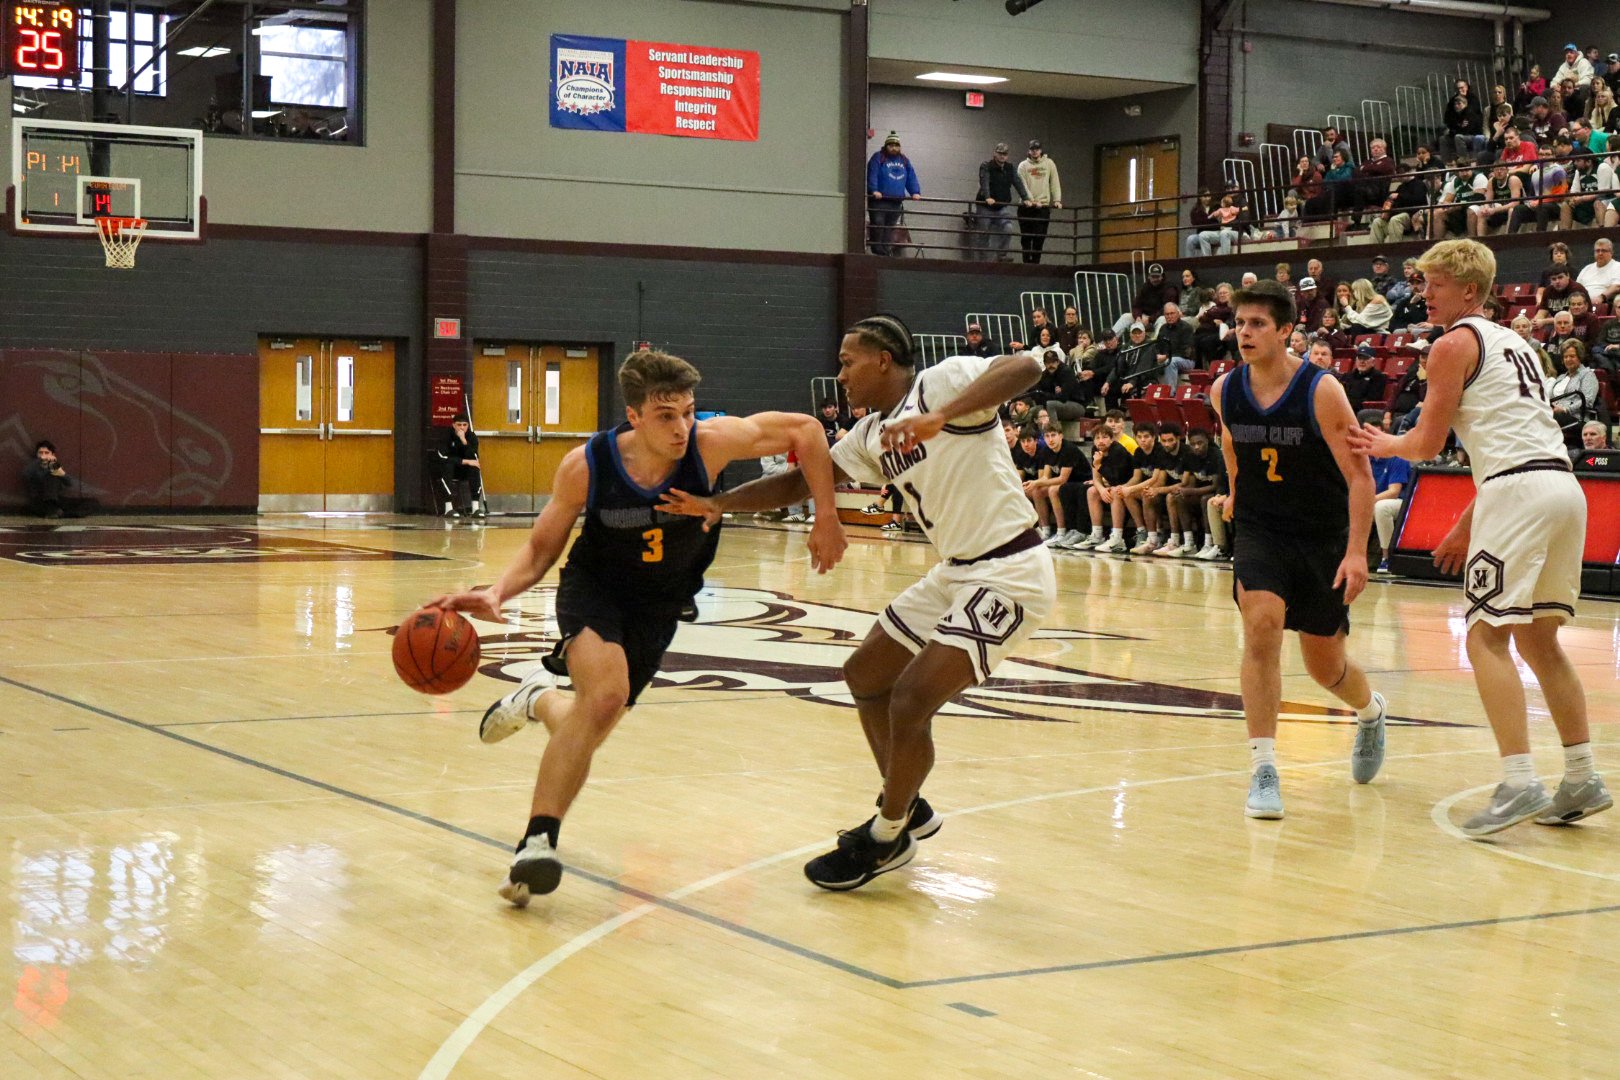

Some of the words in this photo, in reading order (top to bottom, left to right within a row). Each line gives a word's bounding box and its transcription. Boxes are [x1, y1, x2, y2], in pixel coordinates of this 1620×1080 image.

[17, 29, 63, 70] 25
[649, 49, 688, 64] Servant
[689, 53, 744, 69] Leadership
[560, 60, 610, 84] NAIA
[659, 66, 734, 84] Sportsmanship
[566, 84, 604, 93] Champions
[573, 92, 606, 101] Character
[660, 83, 731, 101] Responsibility
[675, 100, 717, 116] Integrity
[676, 116, 716, 131] Respect
[1503, 347, 1546, 402] 24
[1261, 447, 1283, 482] 2
[642, 527, 664, 563] 3
